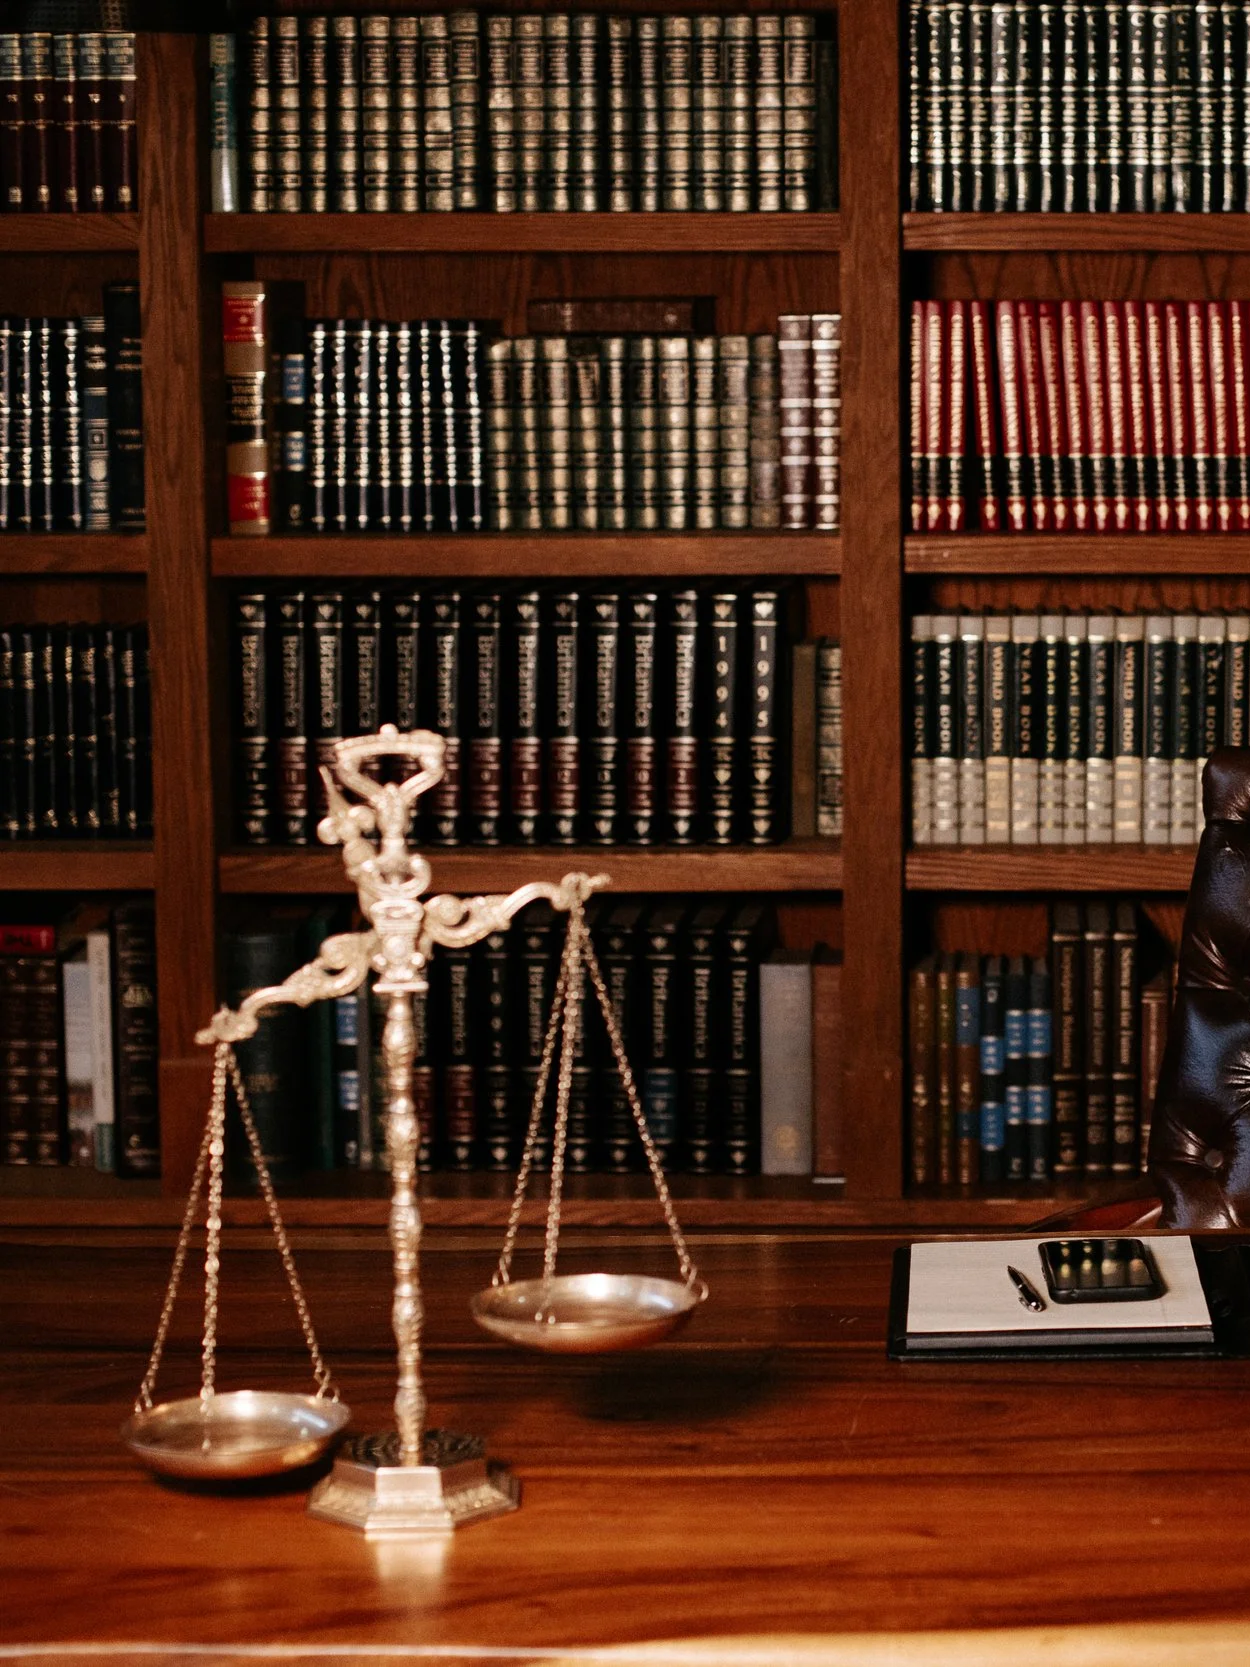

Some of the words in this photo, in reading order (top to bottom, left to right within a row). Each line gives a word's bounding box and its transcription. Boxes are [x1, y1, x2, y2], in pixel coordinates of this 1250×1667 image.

[242, 634, 258, 728] Britannica
[282, 634, 299, 728] Britannica
[320, 634, 338, 728] Britannica
[358, 634, 375, 728] Britannica
[396, 634, 413, 728] Britannica
[436, 634, 454, 728] Britannica
[477, 634, 494, 728] Britannica
[518, 634, 536, 728] Britannica
[556, 634, 574, 728] Britannica
[597, 634, 615, 728] Britannica
[634, 634, 653, 728] Britannica
[675, 634, 694, 728] Britannica
[716, 636, 729, 727] 1994
[756, 636, 770, 727] 1995
[914, 646, 926, 696] YEAR
[939, 646, 952, 696] YEAR
[992, 646, 1004, 700] WORLD
[1020, 646, 1032, 696] YEAR
[1095, 646, 1106, 696] YEAR
[1123, 646, 1135, 700] WORLD
[1153, 646, 1164, 696] YEAR
[1206, 646, 1218, 696] YEAR
[1232, 646, 1244, 700] WORLD
[914, 704, 925, 754] BOOK
[939, 704, 951, 754] BOOK
[992, 704, 1003, 754] BOOK
[1020, 704, 1031, 754] BOOK
[1095, 704, 1106, 754] BOOK
[1122, 704, 1134, 754] BOOK
[1153, 704, 1163, 754] BOOK
[1205, 704, 1216, 754] BOOK
[1232, 704, 1242, 747] BOO
[449, 965, 468, 1056] Britannica
[651, 967, 668, 1060] Britannica
[694, 968, 712, 1060] Britannica
[732, 968, 748, 1060] Britannica
